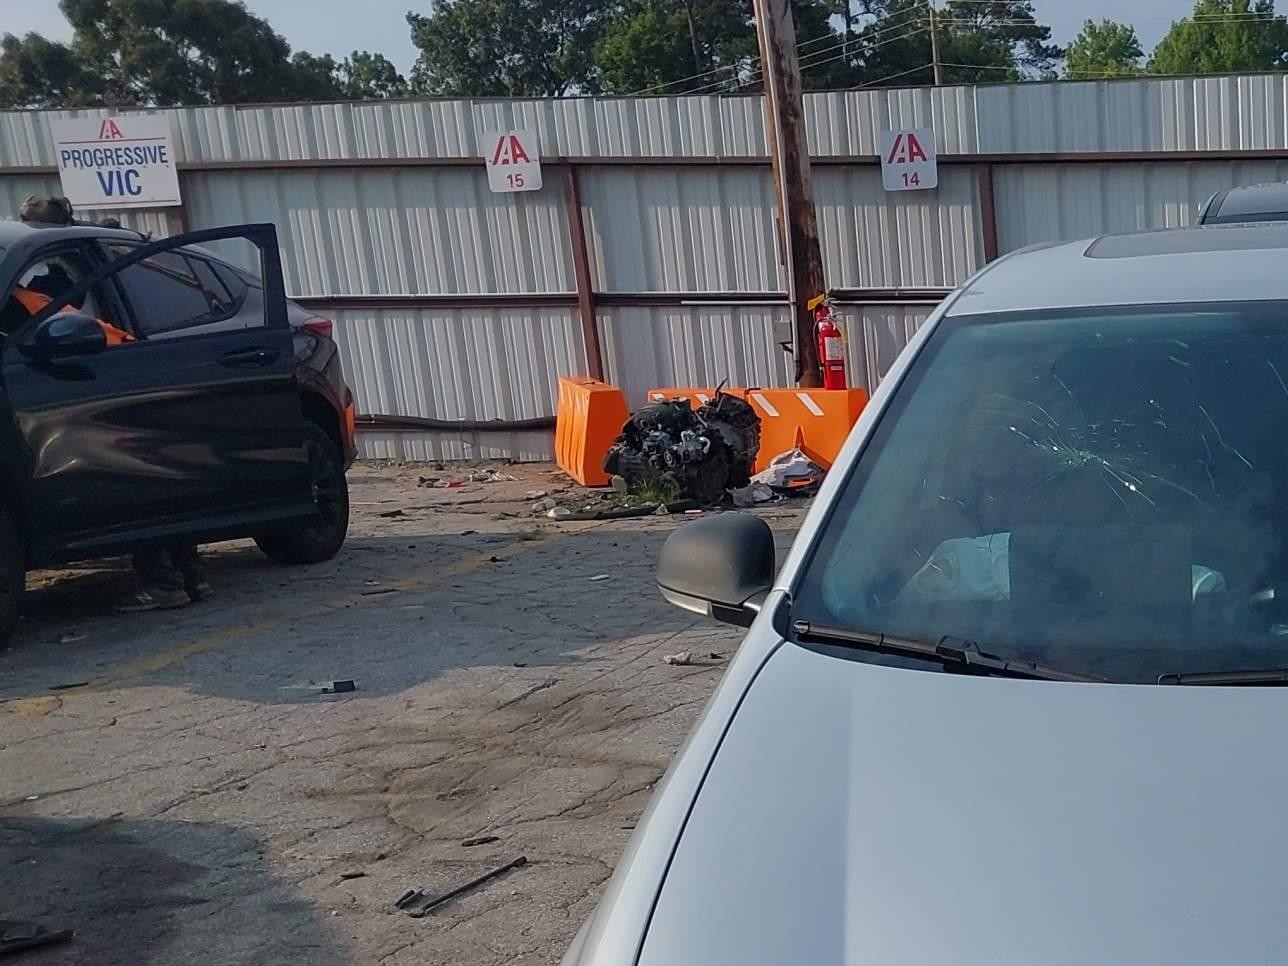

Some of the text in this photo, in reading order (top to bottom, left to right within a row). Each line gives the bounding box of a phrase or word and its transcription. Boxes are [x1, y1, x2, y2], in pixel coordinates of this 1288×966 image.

[60, 145, 168, 168] PROGRESSIVE
[96, 168, 142, 197] VIC
[506, 173, 524, 188] 15
[902, 171, 920, 187] 14
